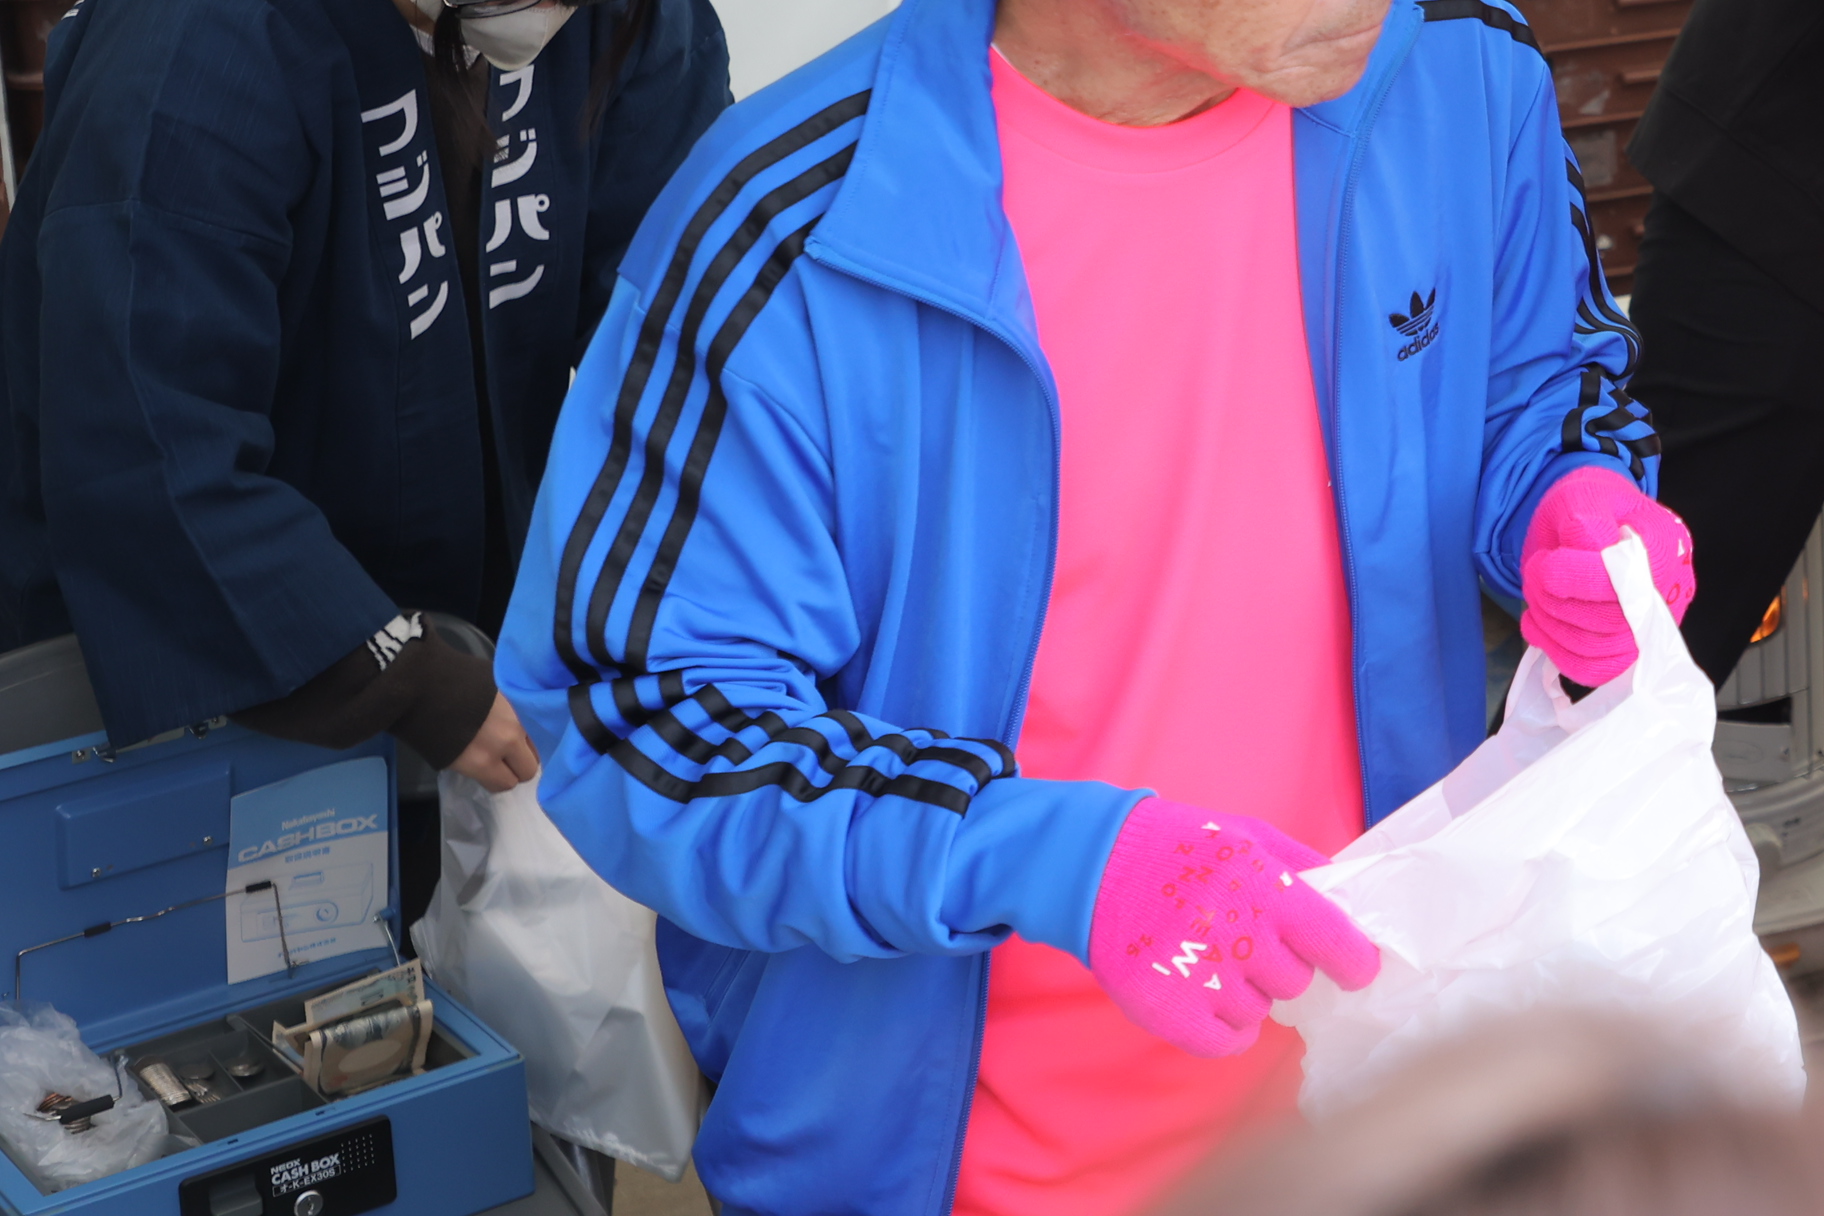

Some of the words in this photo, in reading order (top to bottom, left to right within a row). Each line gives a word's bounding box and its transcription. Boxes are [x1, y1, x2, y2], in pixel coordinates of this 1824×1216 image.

[486, 64, 550, 309] フジパン
[360, 89, 448, 340] フジパン
[1397, 322, 1441, 361] adidas
[238, 814, 378, 863] CASHBOX
[271, 1164, 309, 1185] CASH
[311, 1153, 341, 1173] BOX
